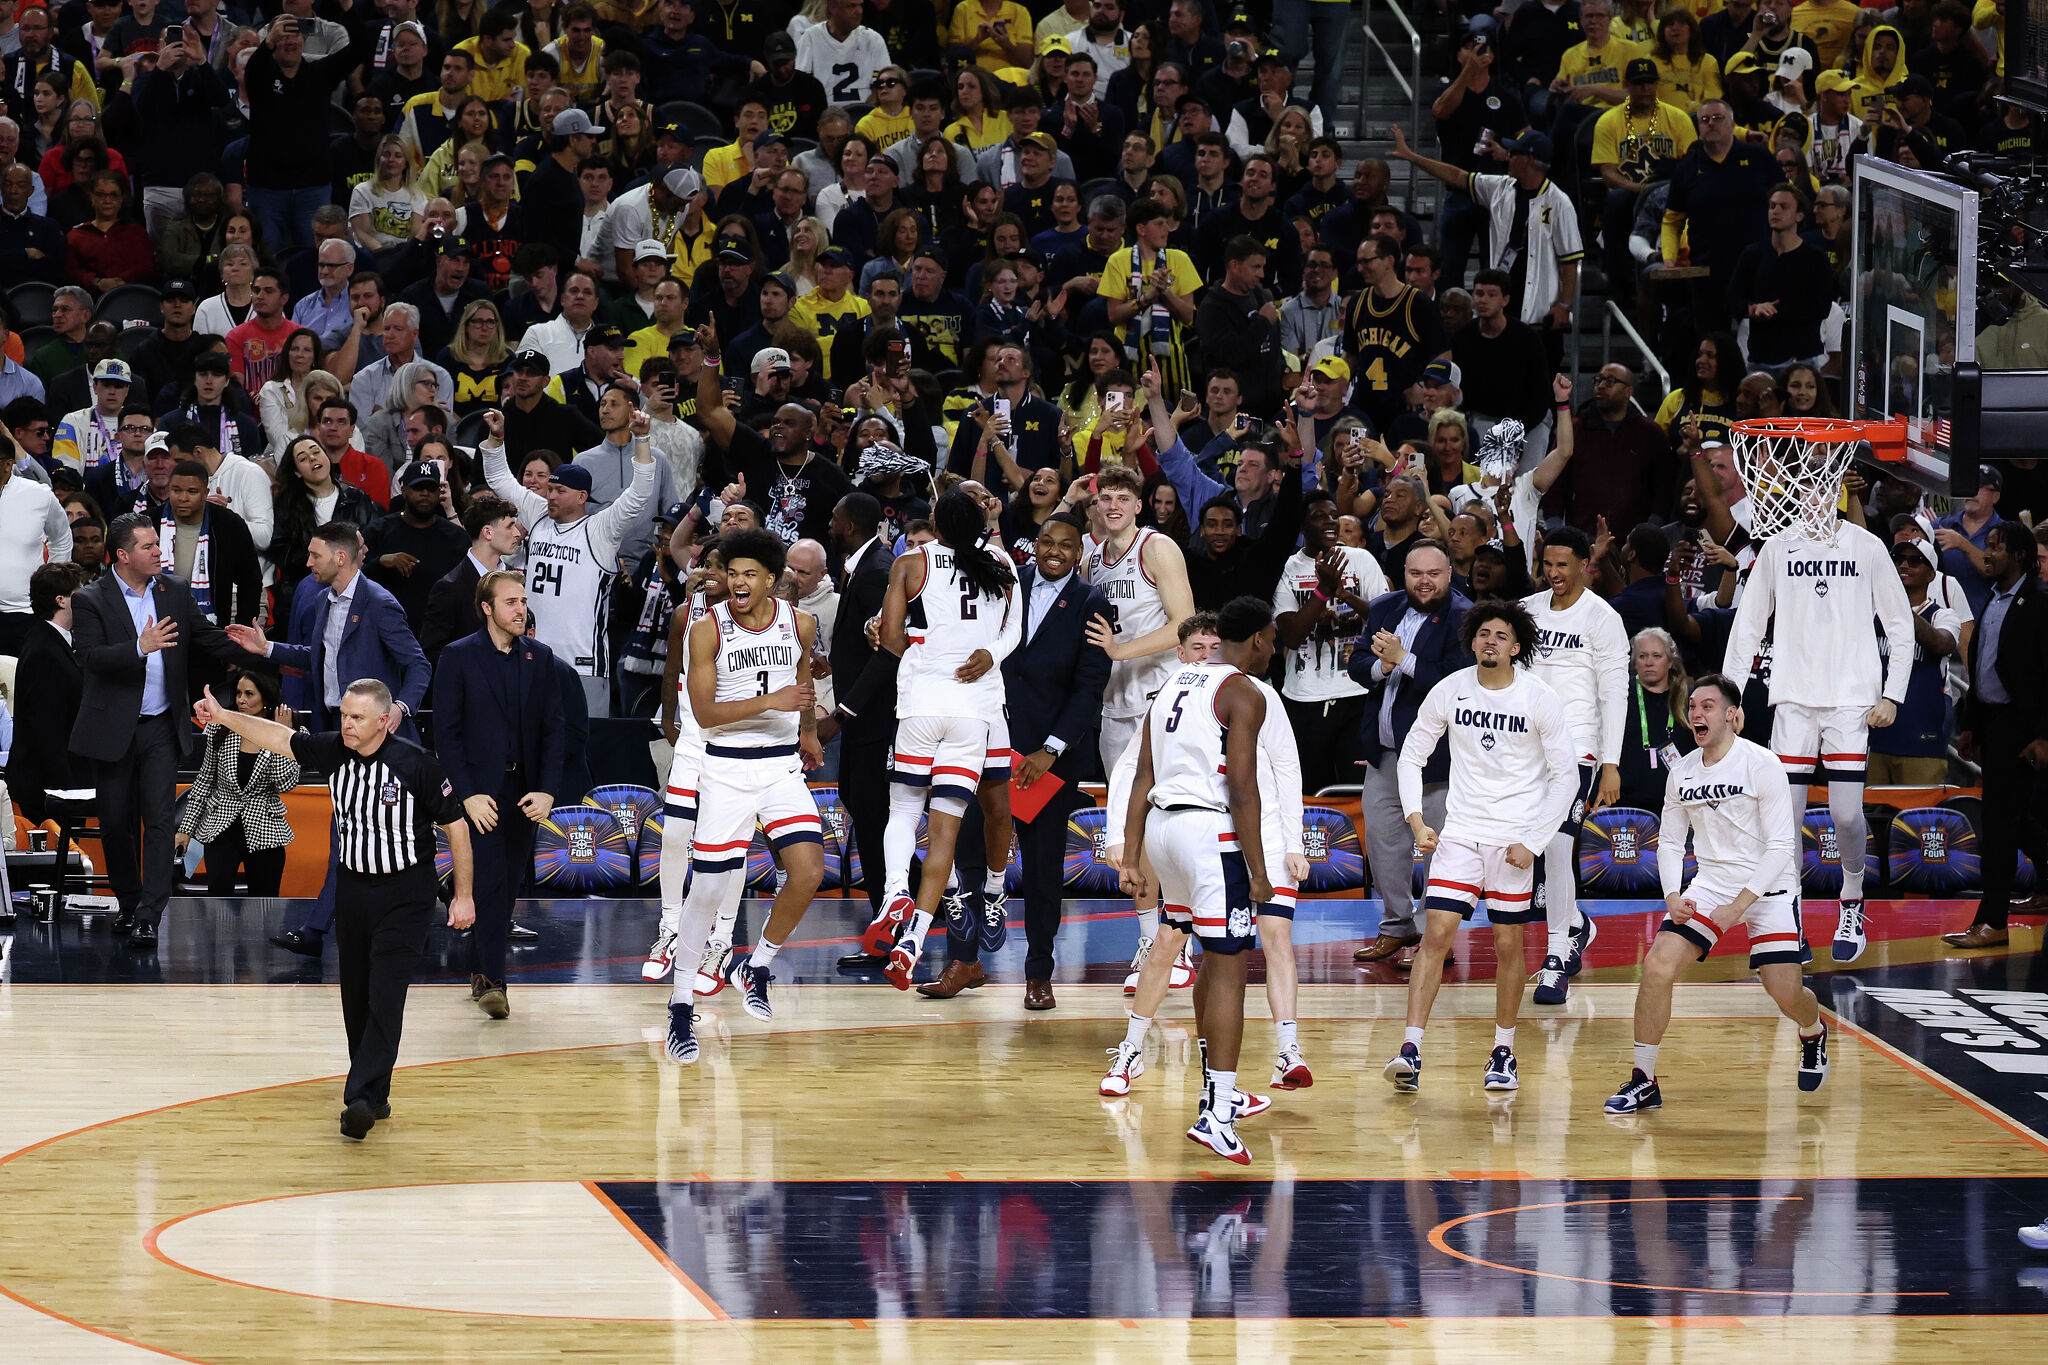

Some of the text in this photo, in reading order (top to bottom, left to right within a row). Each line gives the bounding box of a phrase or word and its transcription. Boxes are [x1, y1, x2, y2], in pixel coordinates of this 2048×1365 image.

[1589, 56, 1601, 66] M
[1783, 56, 1794, 65] M
[1638, 63, 1649, 73] M
[832, 62, 859, 102] 2
[524, 350, 536, 360] P
[1365, 357, 1388, 390] 4
[455, 372, 499, 403] M
[1025, 420, 1040, 431] M
[530, 542, 581, 567] CONNECTICUT
[1788, 561, 1859, 576] LOCK IT IN.
[532, 561, 564, 597] 24
[960, 577, 980, 620] 2
[1552, 632, 1567, 648] IT
[1565, 634, 1584, 649] IN.
[728, 645, 793, 673] CONNECTICUT
[757, 671, 769, 696] 3
[1165, 690, 1189, 732] 5
[1455, 709, 1529, 733] LOCK IT IN.
[1713, 785, 1726, 799] IT
[570, 831, 593, 841] FINAL
[1303, 832, 1326, 841] FINAL
[1612, 833, 1636, 842] FINAL
[1922, 832, 1945, 841] FINAL
[571, 848, 593, 857] FOUR
[1305, 849, 1326, 857] FOUR
[1614, 850, 1637, 859] FOUR
[1923, 849, 1945, 858] FOUR
